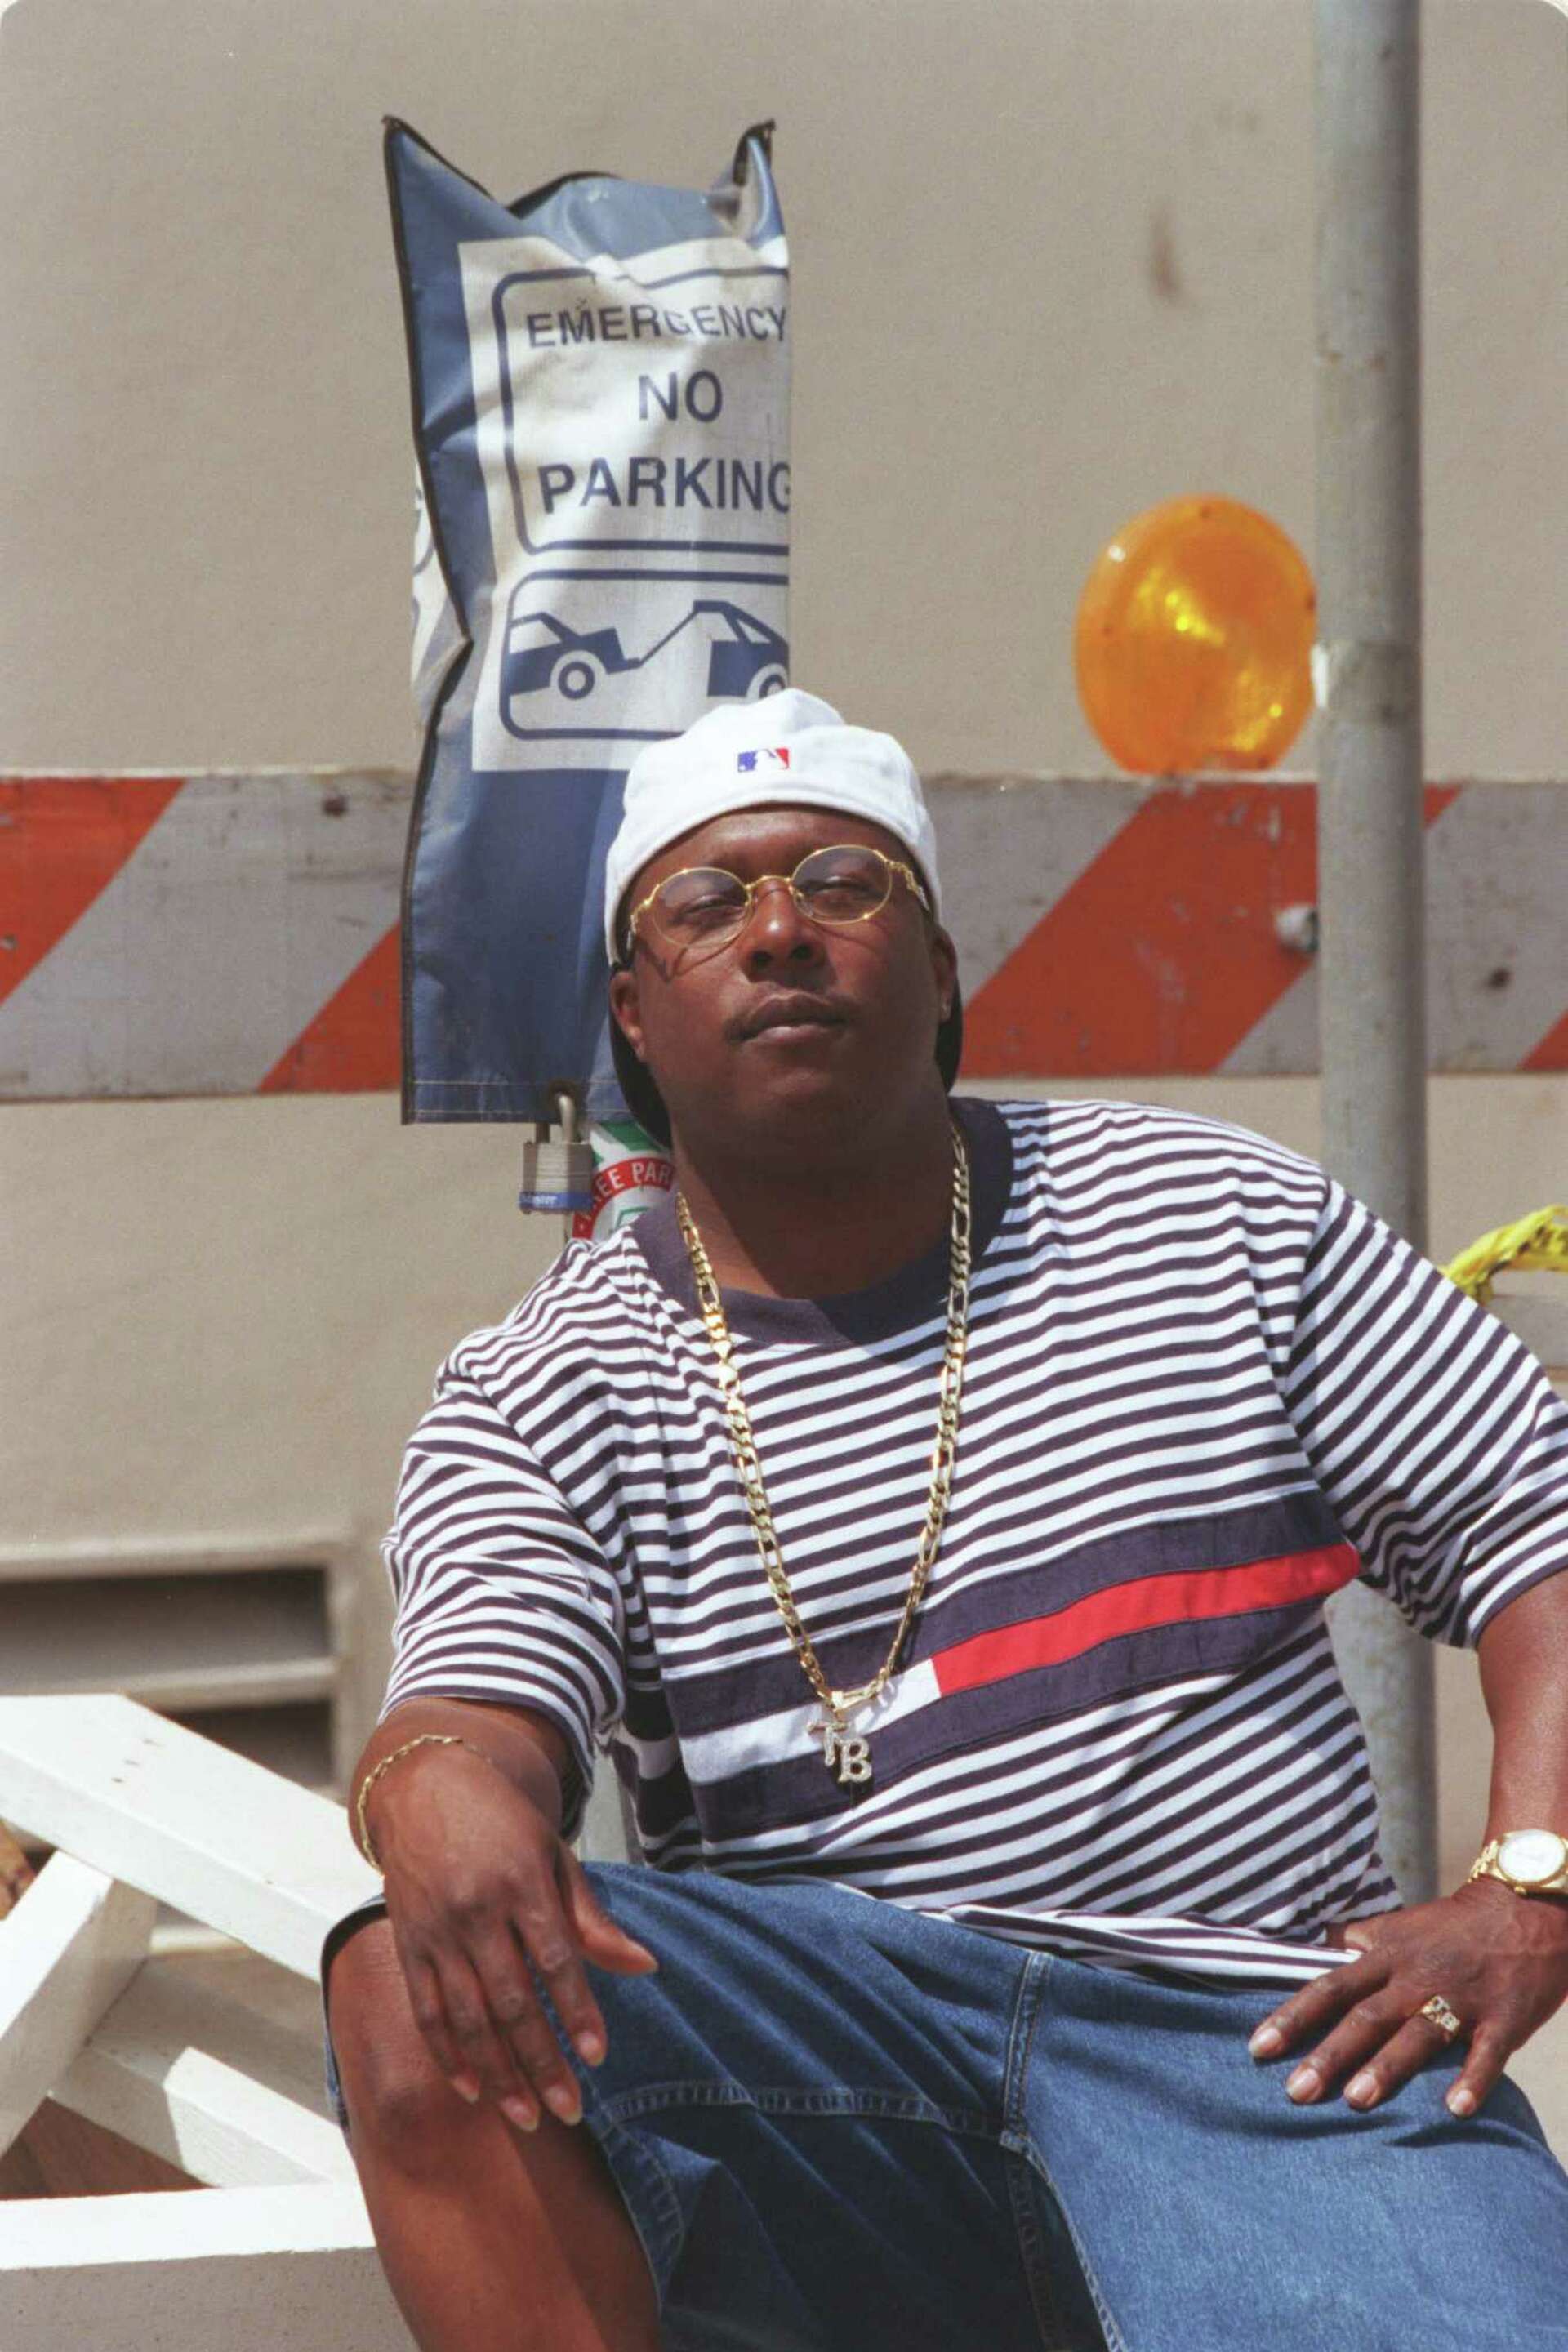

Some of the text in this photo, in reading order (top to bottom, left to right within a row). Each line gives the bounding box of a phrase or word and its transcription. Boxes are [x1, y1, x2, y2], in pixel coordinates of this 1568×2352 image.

[526, 304, 786, 347] EMERGENCY
[639, 369, 724, 422] NO
[537, 457, 790, 514] PARKING
[806, 1721, 872, 1783] TB
